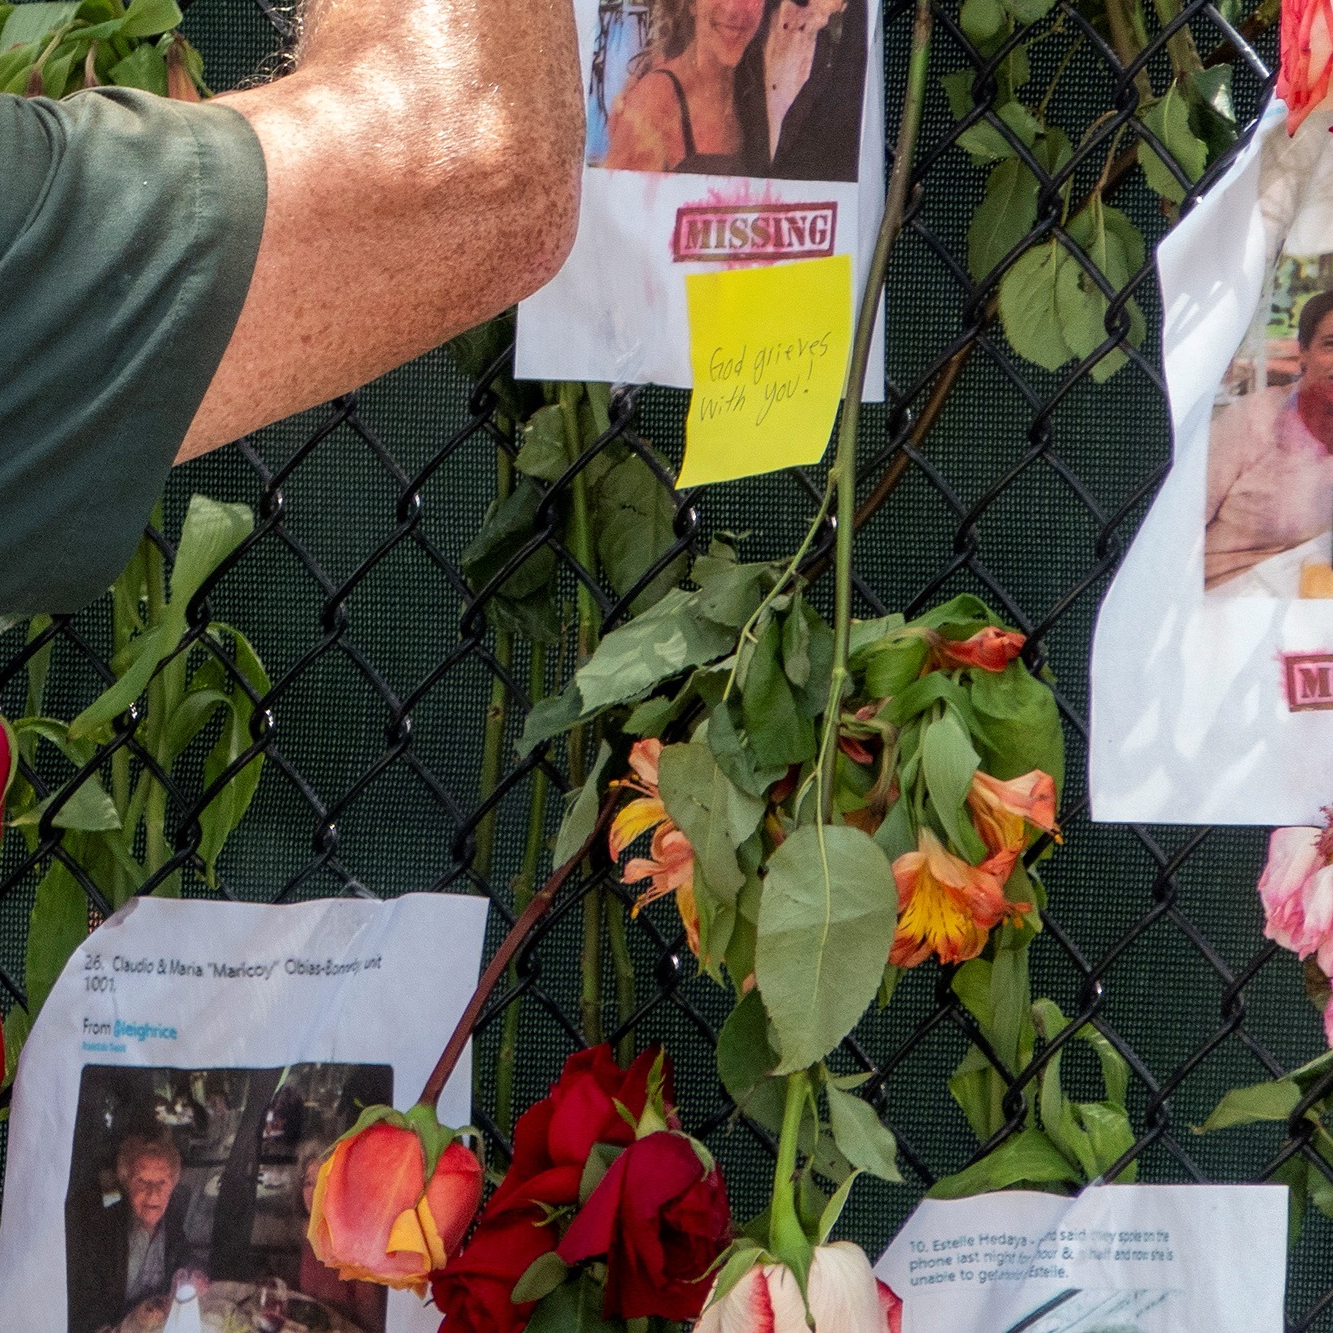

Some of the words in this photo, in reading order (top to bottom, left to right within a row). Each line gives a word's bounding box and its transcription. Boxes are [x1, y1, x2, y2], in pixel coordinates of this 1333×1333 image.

[684, 215, 829, 250] MISSING
[709, 344, 747, 383] God
[753, 331, 832, 386] grieves
[755, 360, 813, 427] you!
[113, 954, 154, 974] Claudio
[157, 958, 167, 975] &
[169, 958, 203, 977] Maria
[83, 1018, 111, 1035] From
[910, 1240, 929, 1253] 10.
[933, 1235, 975, 1252] Estelle
[978, 1232, 1027, 1249] Hedaya
[1060, 1229, 1086, 1241] said
[909, 1256, 953, 1272] phone
[956, 1251, 980, 1264] last
[983, 1249, 1015, 1266] night
[910, 1270, 956, 1286] unable
[960, 1269, 975, 1281] to
